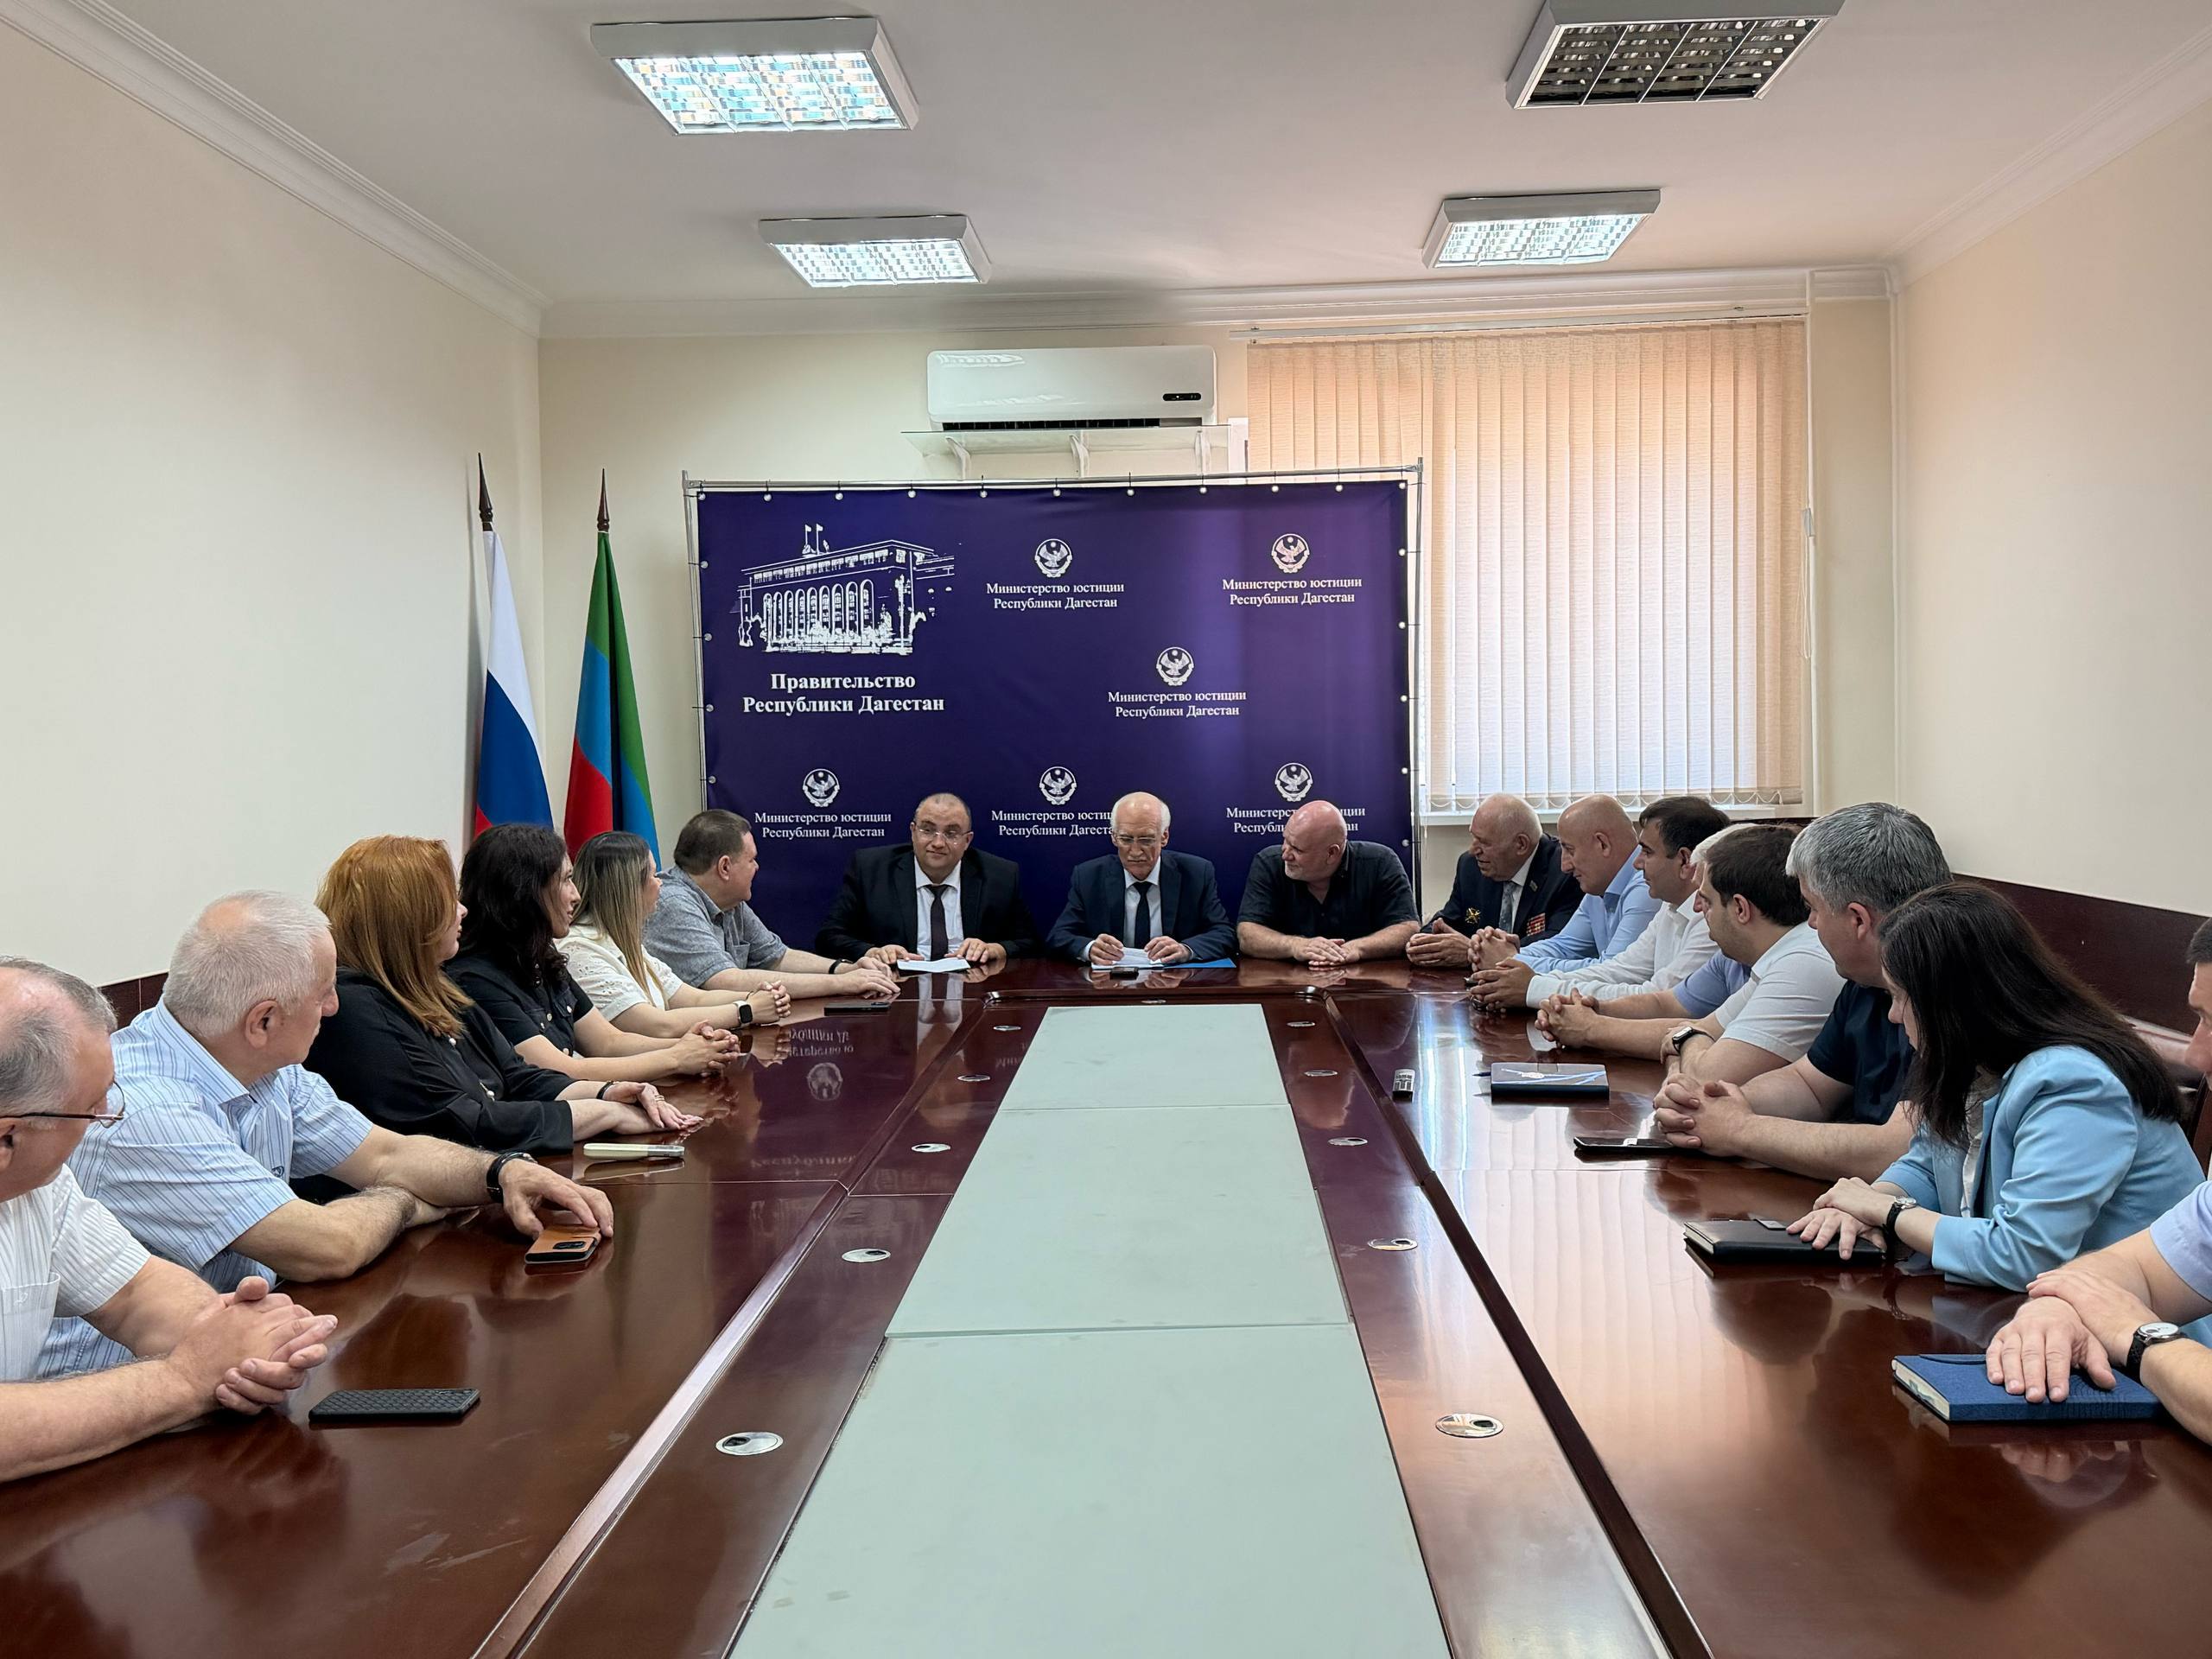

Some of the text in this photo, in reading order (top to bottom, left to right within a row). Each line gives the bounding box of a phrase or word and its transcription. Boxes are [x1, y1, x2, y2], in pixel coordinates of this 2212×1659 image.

[987, 583, 1124, 595] Министерство юстиции
[1223, 578, 1362, 591] Министерство юстиции
[994, 597, 1117, 611] Республики Дагестан
[1230, 592, 1355, 607] Республики Дагестан
[771, 673, 916, 693] Правительство
[1108, 691, 1246, 704] Министерство юстиции
[743, 695, 944, 716] Республики Дагестан
[1116, 705, 1239, 719] Республики Дагестан
[754, 812, 891, 824] Министерство юстиции
[991, 810, 1113, 823] Министерство юстиц
[1226, 807, 1298, 819] Министерс
[762, 826, 885, 840] Республики Дагестан
[999, 823, 1113, 838] Республики Дагеста
[1234, 822, 1285, 835] Республ
